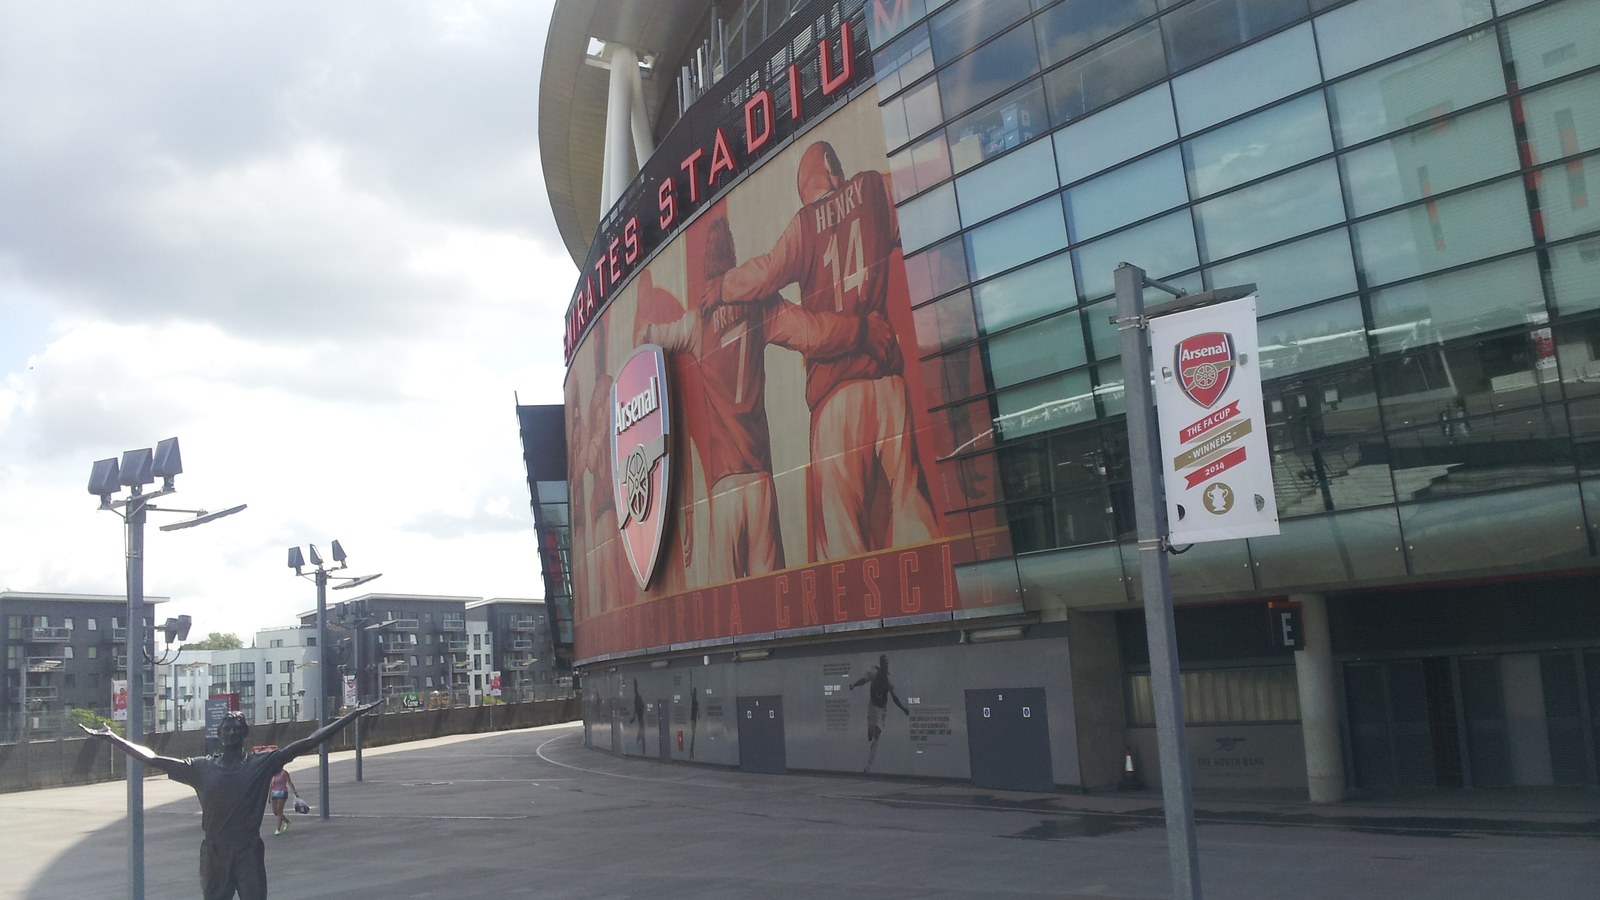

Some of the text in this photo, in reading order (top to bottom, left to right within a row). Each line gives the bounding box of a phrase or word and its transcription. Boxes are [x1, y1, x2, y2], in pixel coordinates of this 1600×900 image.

[657, 0, 911, 231] STADIUM
[815, 177, 864, 234] HENRY
[823, 217, 869, 313] 14
[720, 320, 748, 404] 7
[1181, 342, 1227, 361] Arsenal
[615, 376, 659, 433] Arsenal
[1187, 408, 1231, 438] THE FA CUP
[1192, 432, 1232, 459] WINNERS
[1205, 462, 1225, 476] 2014
[1280, 612, 1295, 646] E
